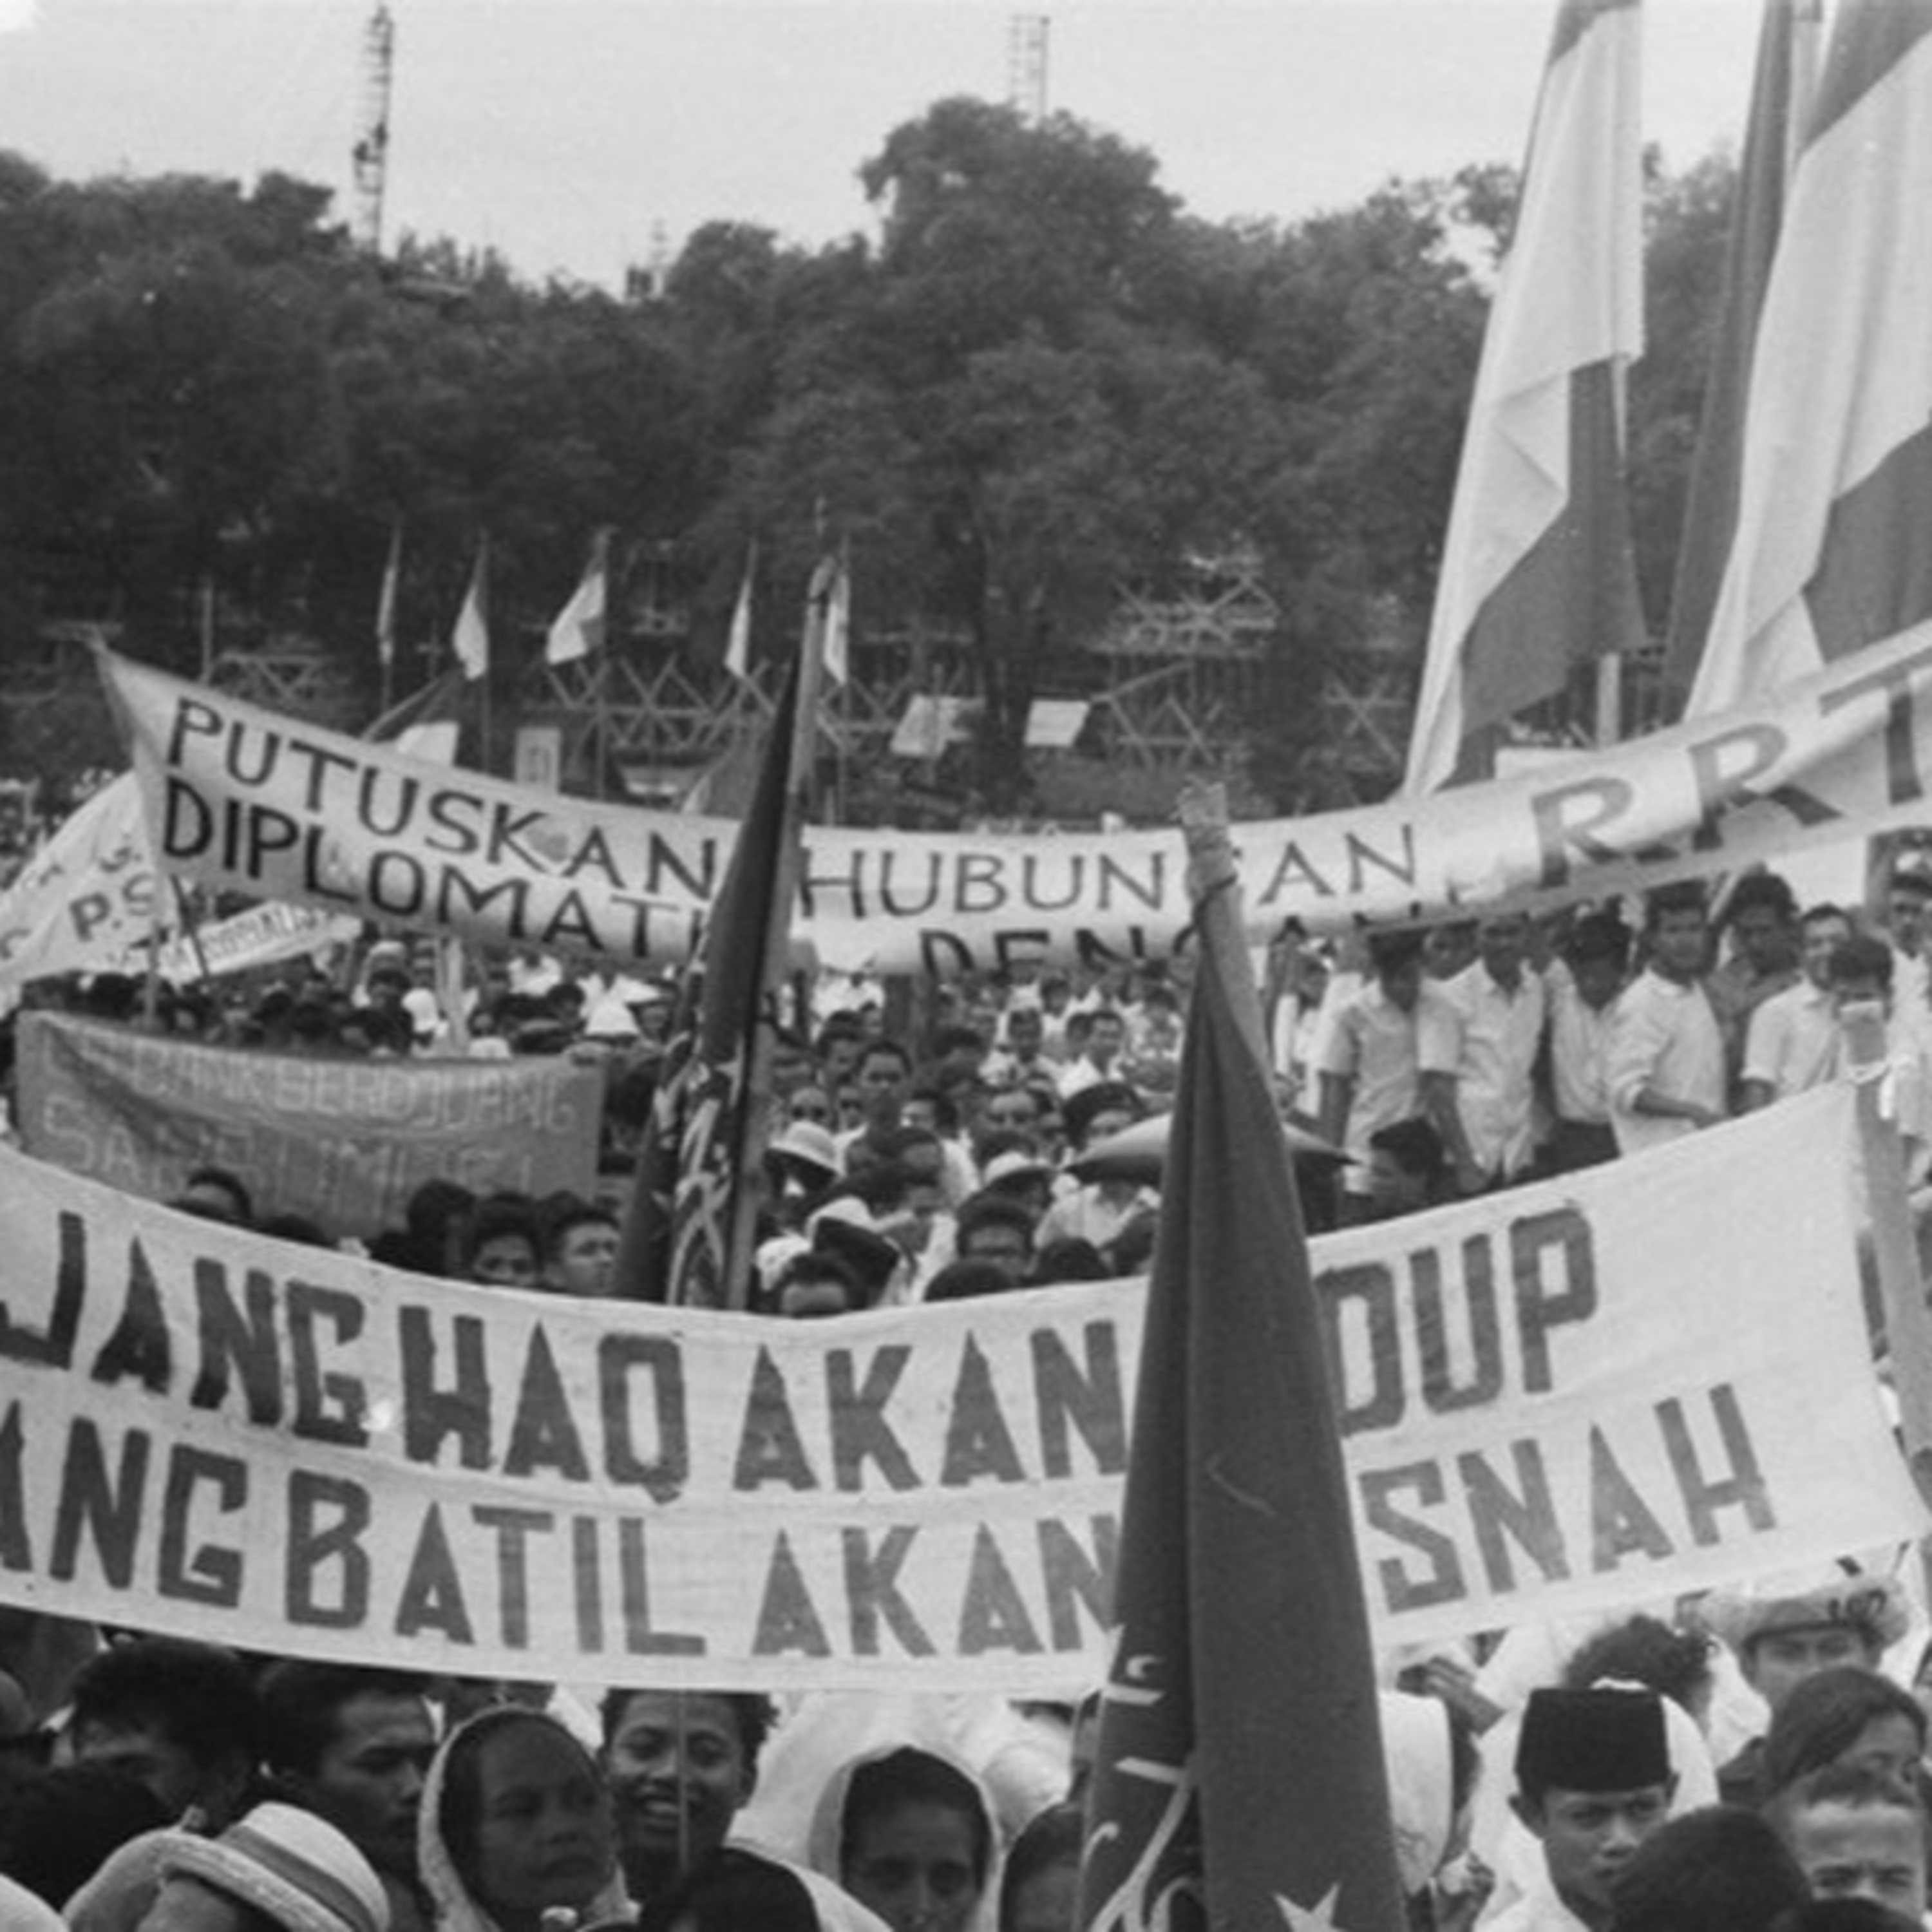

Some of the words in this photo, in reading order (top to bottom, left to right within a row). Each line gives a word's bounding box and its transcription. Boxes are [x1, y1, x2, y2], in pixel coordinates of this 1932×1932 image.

[164, 775, 705, 960] DIPLOMATI
[169, 697, 716, 900] PUTUSKAN
[799, 822, 1414, 920] HUBUNAN
[398, 1305, 689, 1504] HAQ
[732, 1320, 1128, 1492] AKAN
[1311, 1204, 1598, 1440] DUP
[0, 1396, 249, 1609] ANG
[285, 1467, 706, 1658] BATIL
[751, 1513, 1122, 1659] AKAN
[1356, 1382, 1777, 1615] SNAH
